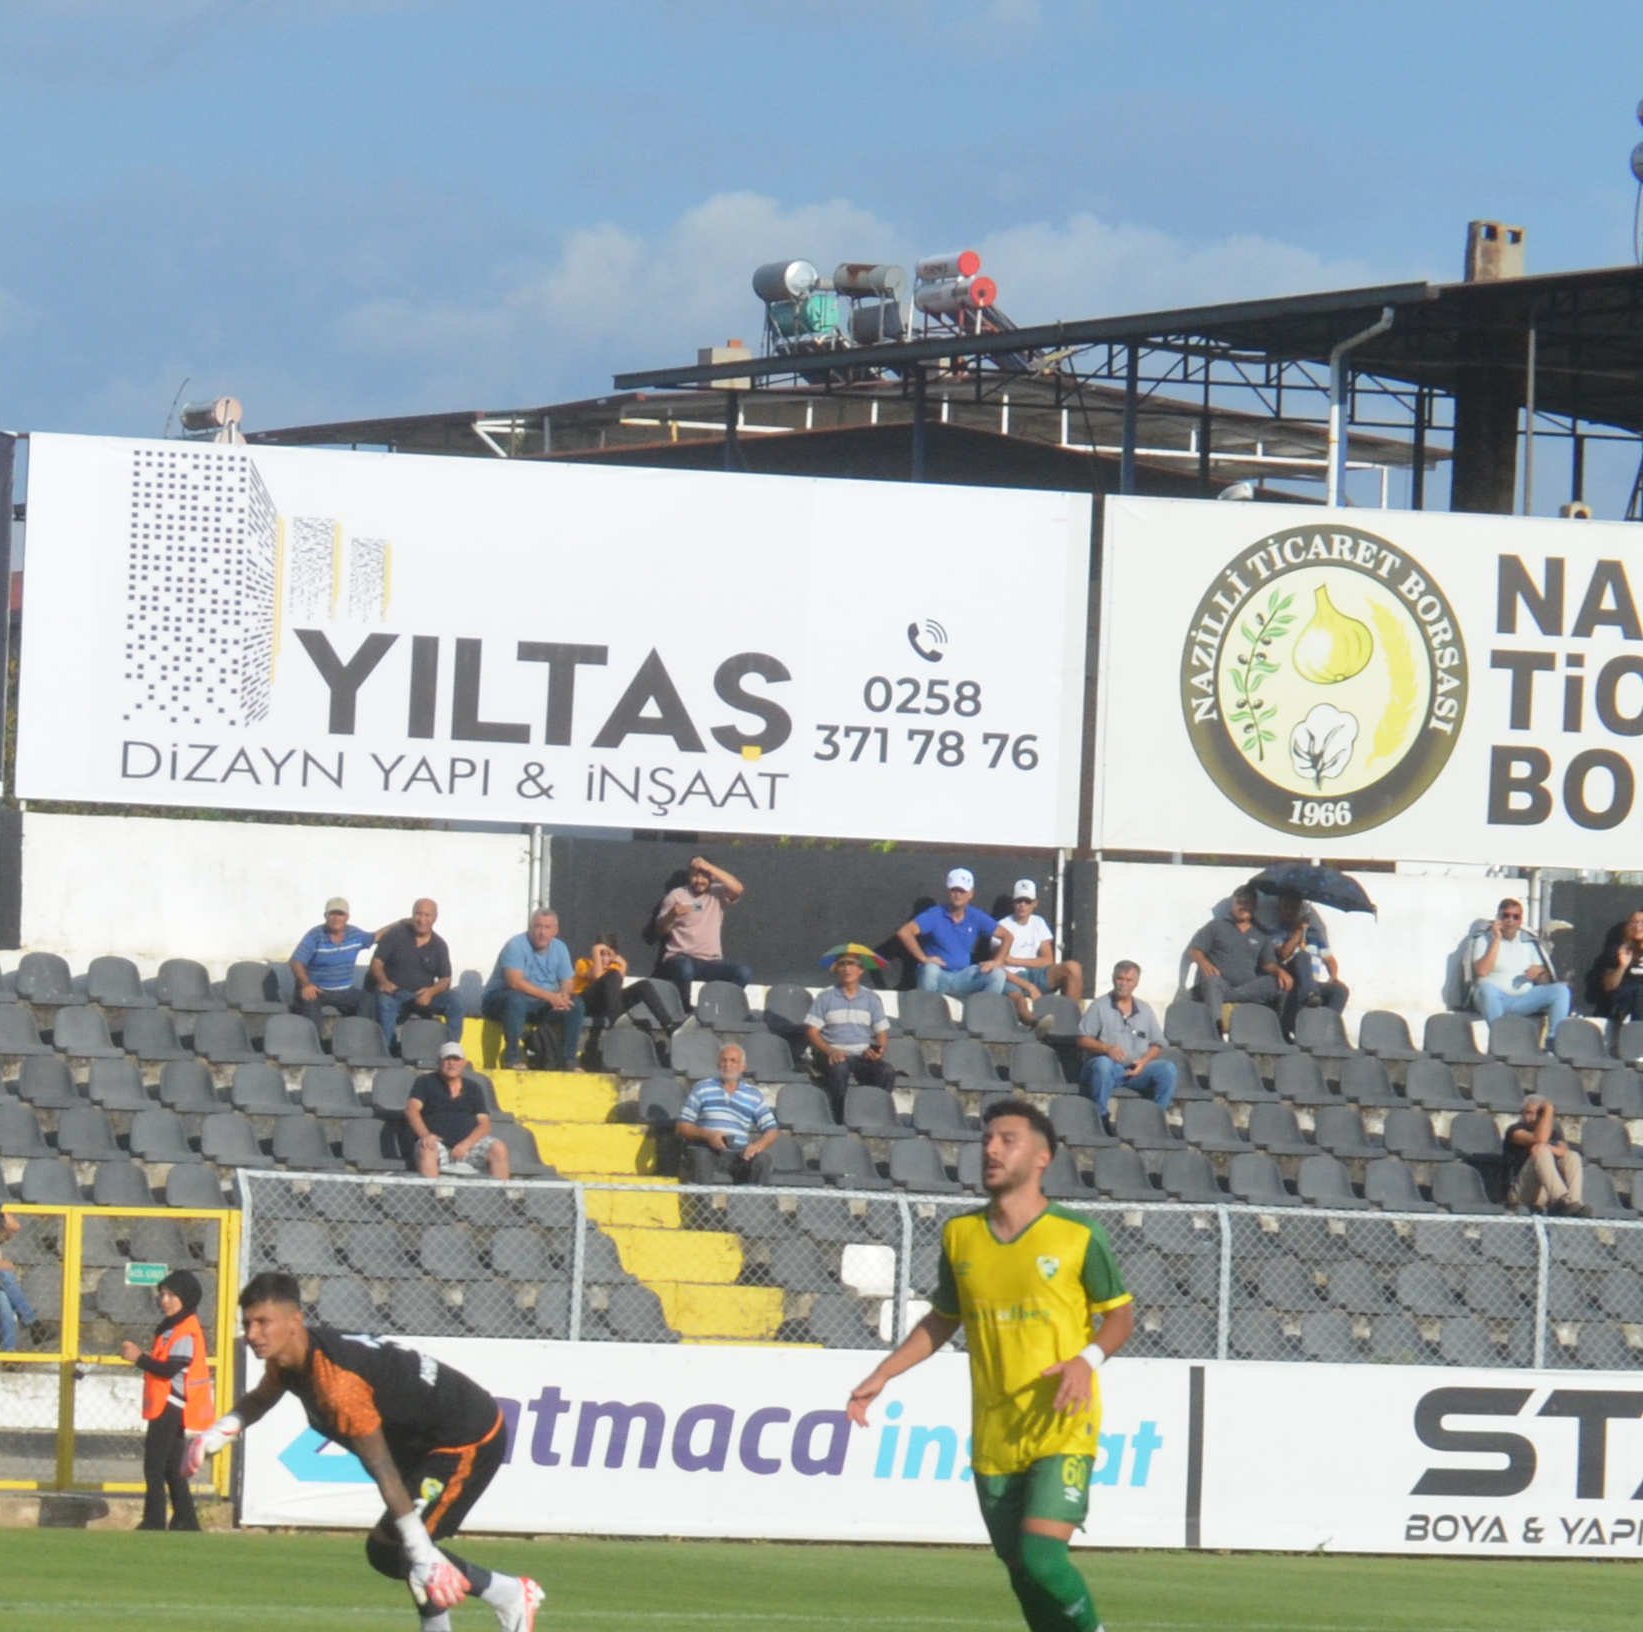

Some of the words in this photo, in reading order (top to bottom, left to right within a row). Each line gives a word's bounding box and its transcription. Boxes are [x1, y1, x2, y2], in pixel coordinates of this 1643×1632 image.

[1496, 554, 1643, 641] NA
[1245, 533, 1402, 582] TİCARET
[1398, 568, 1462, 736] BORSASI
[293, 629, 792, 761] YILTAŞ
[863, 676, 982, 718] 0258
[370, 752, 491, 797] YAPI
[516, 761, 554, 800] &
[814, 724, 889, 764] 371
[907, 729, 965, 768] 78
[982, 733, 1040, 771] 76
[1288, 799, 1353, 827] 1966
[1487, 745, 1636, 831] BO
[1409, 1387, 1643, 1500] ST
[1405, 1513, 1509, 1544] BOYA
[1521, 1516, 1545, 1545] &
